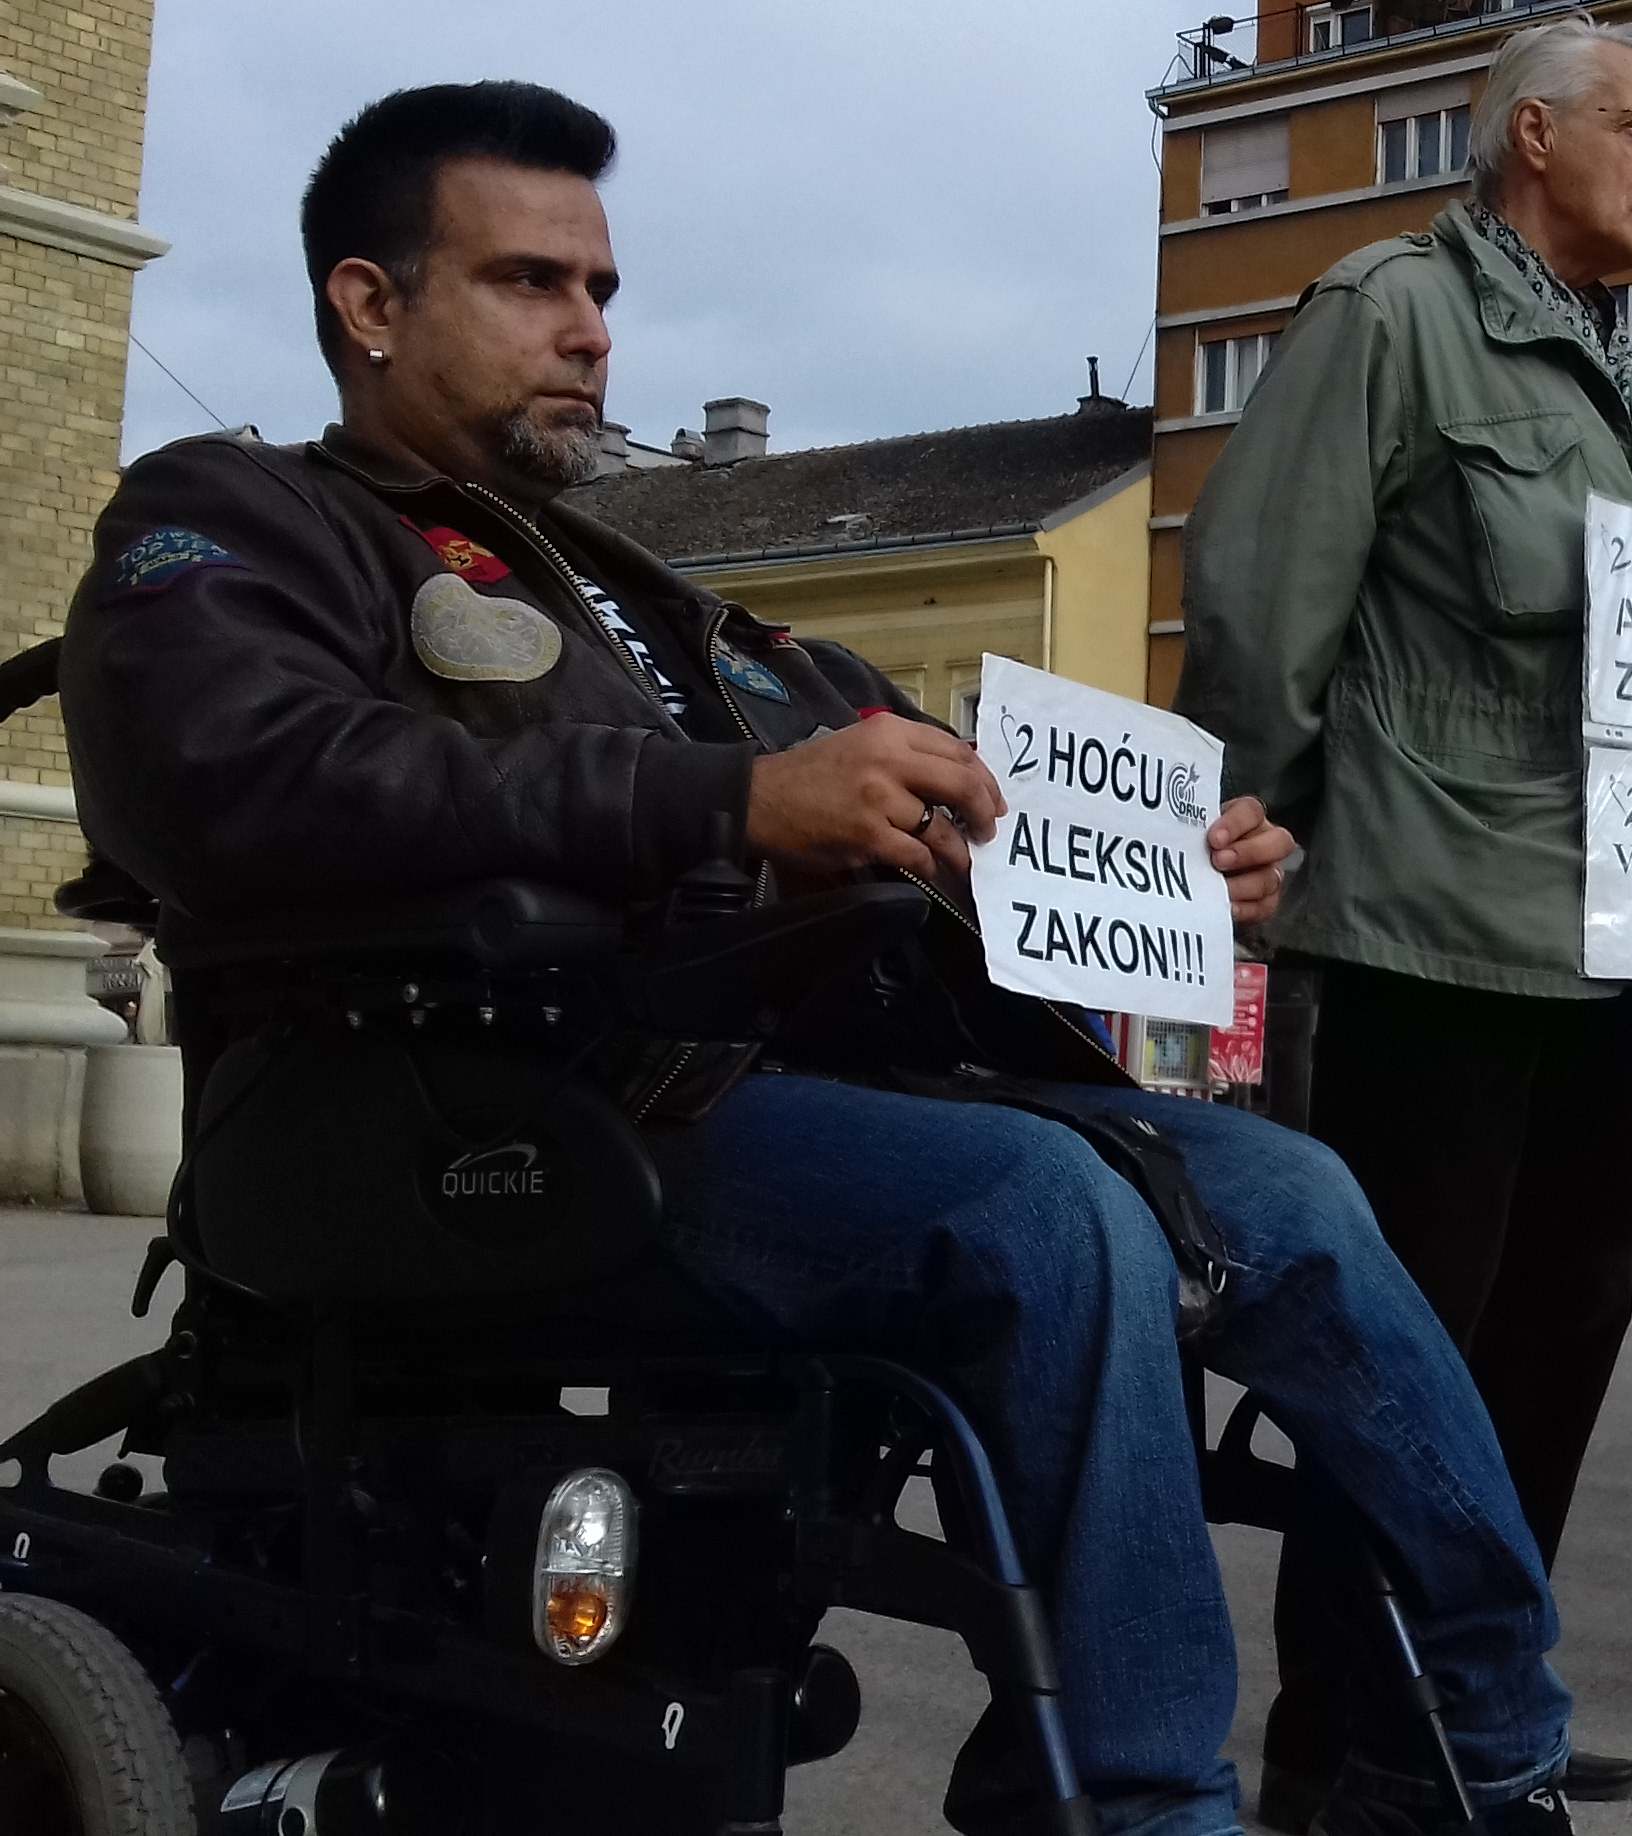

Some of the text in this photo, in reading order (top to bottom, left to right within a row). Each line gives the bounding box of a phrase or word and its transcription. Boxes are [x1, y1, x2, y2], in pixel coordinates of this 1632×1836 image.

[1610, 537, 1631, 574] 2
[1007, 722, 1163, 809] 2 HOĆU
[1178, 801, 1207, 821] DRUG
[1008, 811, 1192, 901] ALEKSIN
[1012, 901, 1206, 986] ZAKON!!!
[443, 1170, 544, 1198] QUICKIE
